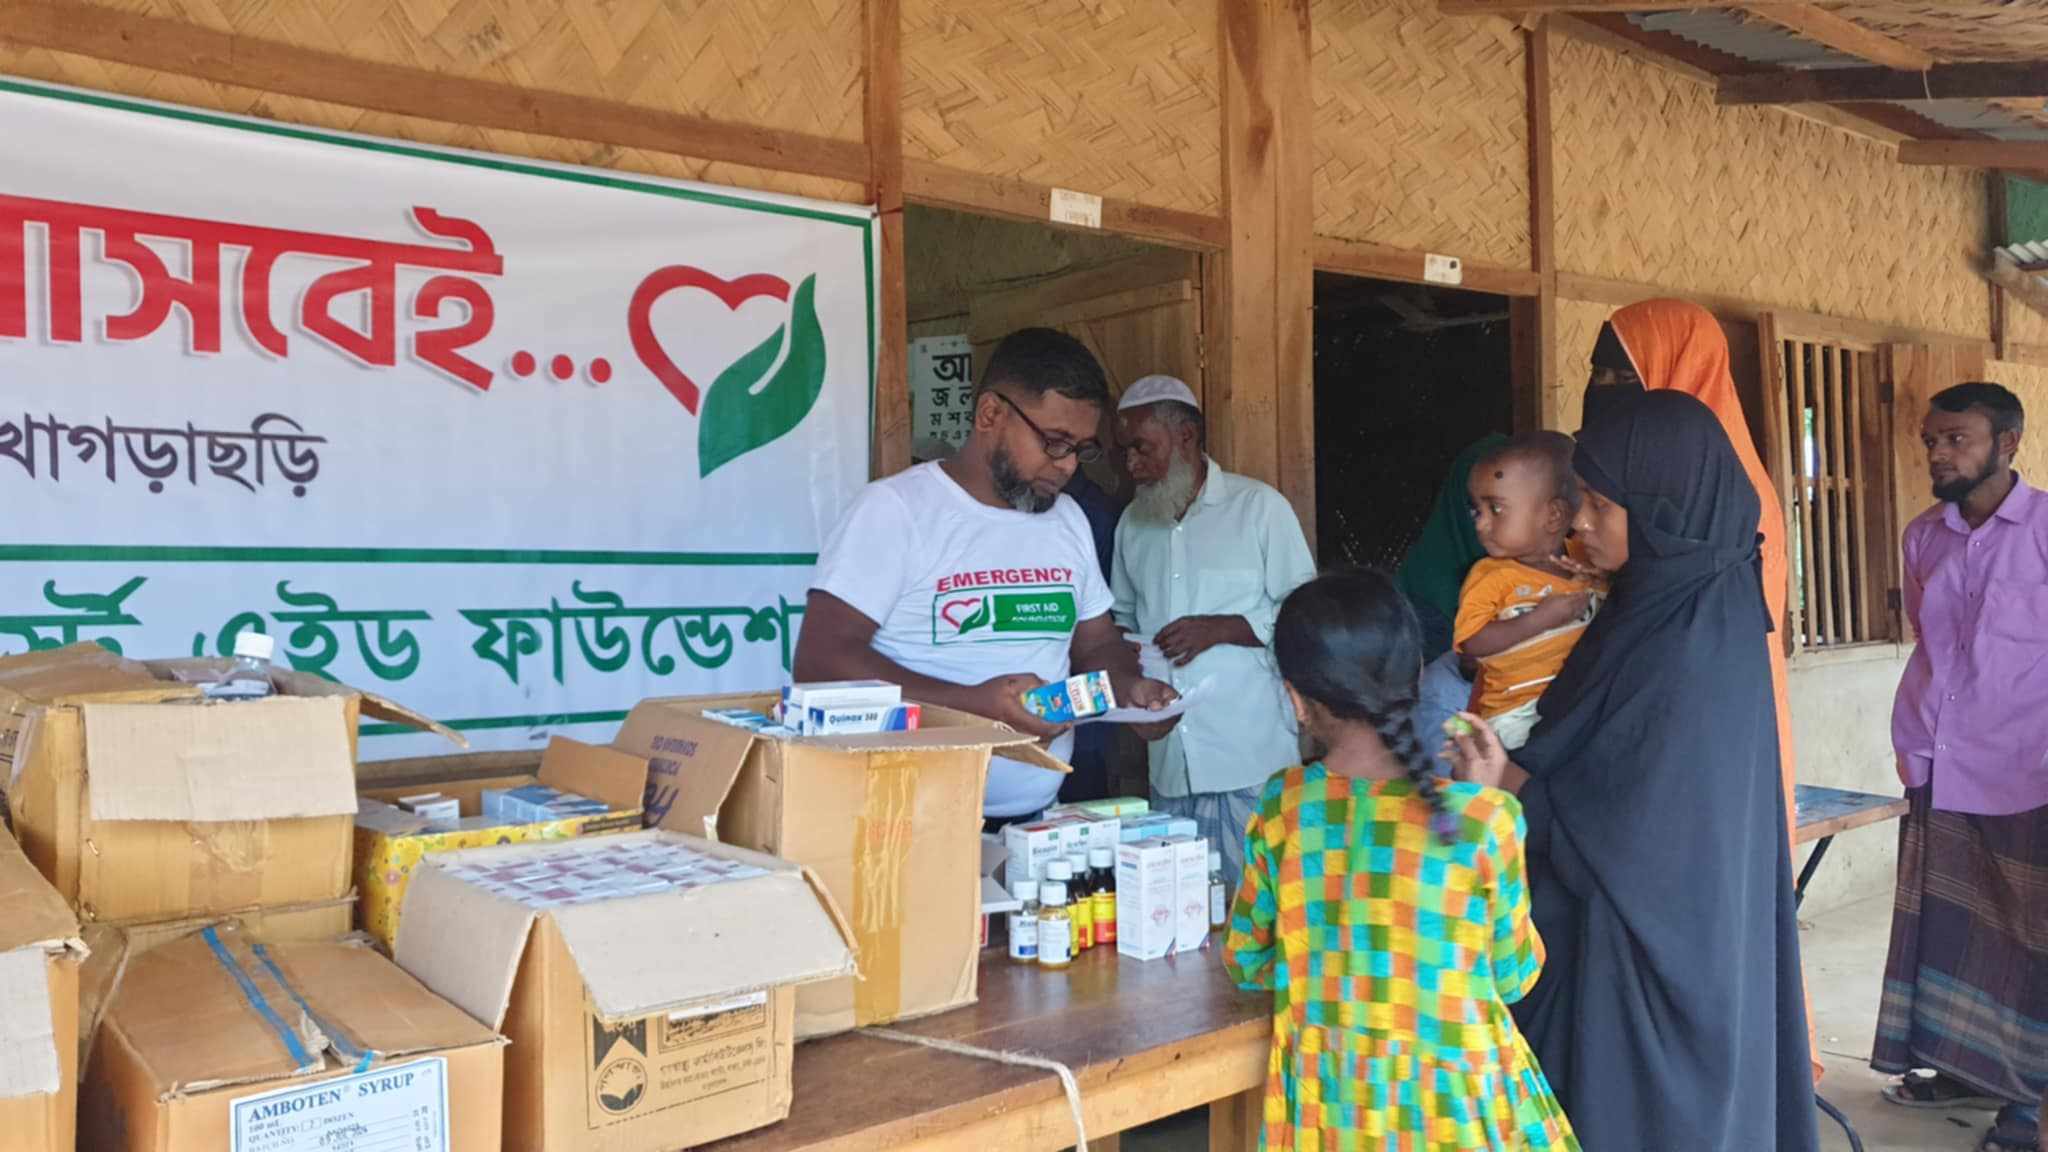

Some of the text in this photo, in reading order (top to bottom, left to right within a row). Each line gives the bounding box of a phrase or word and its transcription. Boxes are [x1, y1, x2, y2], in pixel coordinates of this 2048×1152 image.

[0, 412, 327, 498] খাগড়াছড়ি
[937, 568, 1072, 592] EMERGENCY
[1016, 603, 1059, 613] FIRST AID
[458, 580, 806, 686] ফাউন্ডেশ
[249, 1073, 414, 1122] AMBOTEN SYRUP
